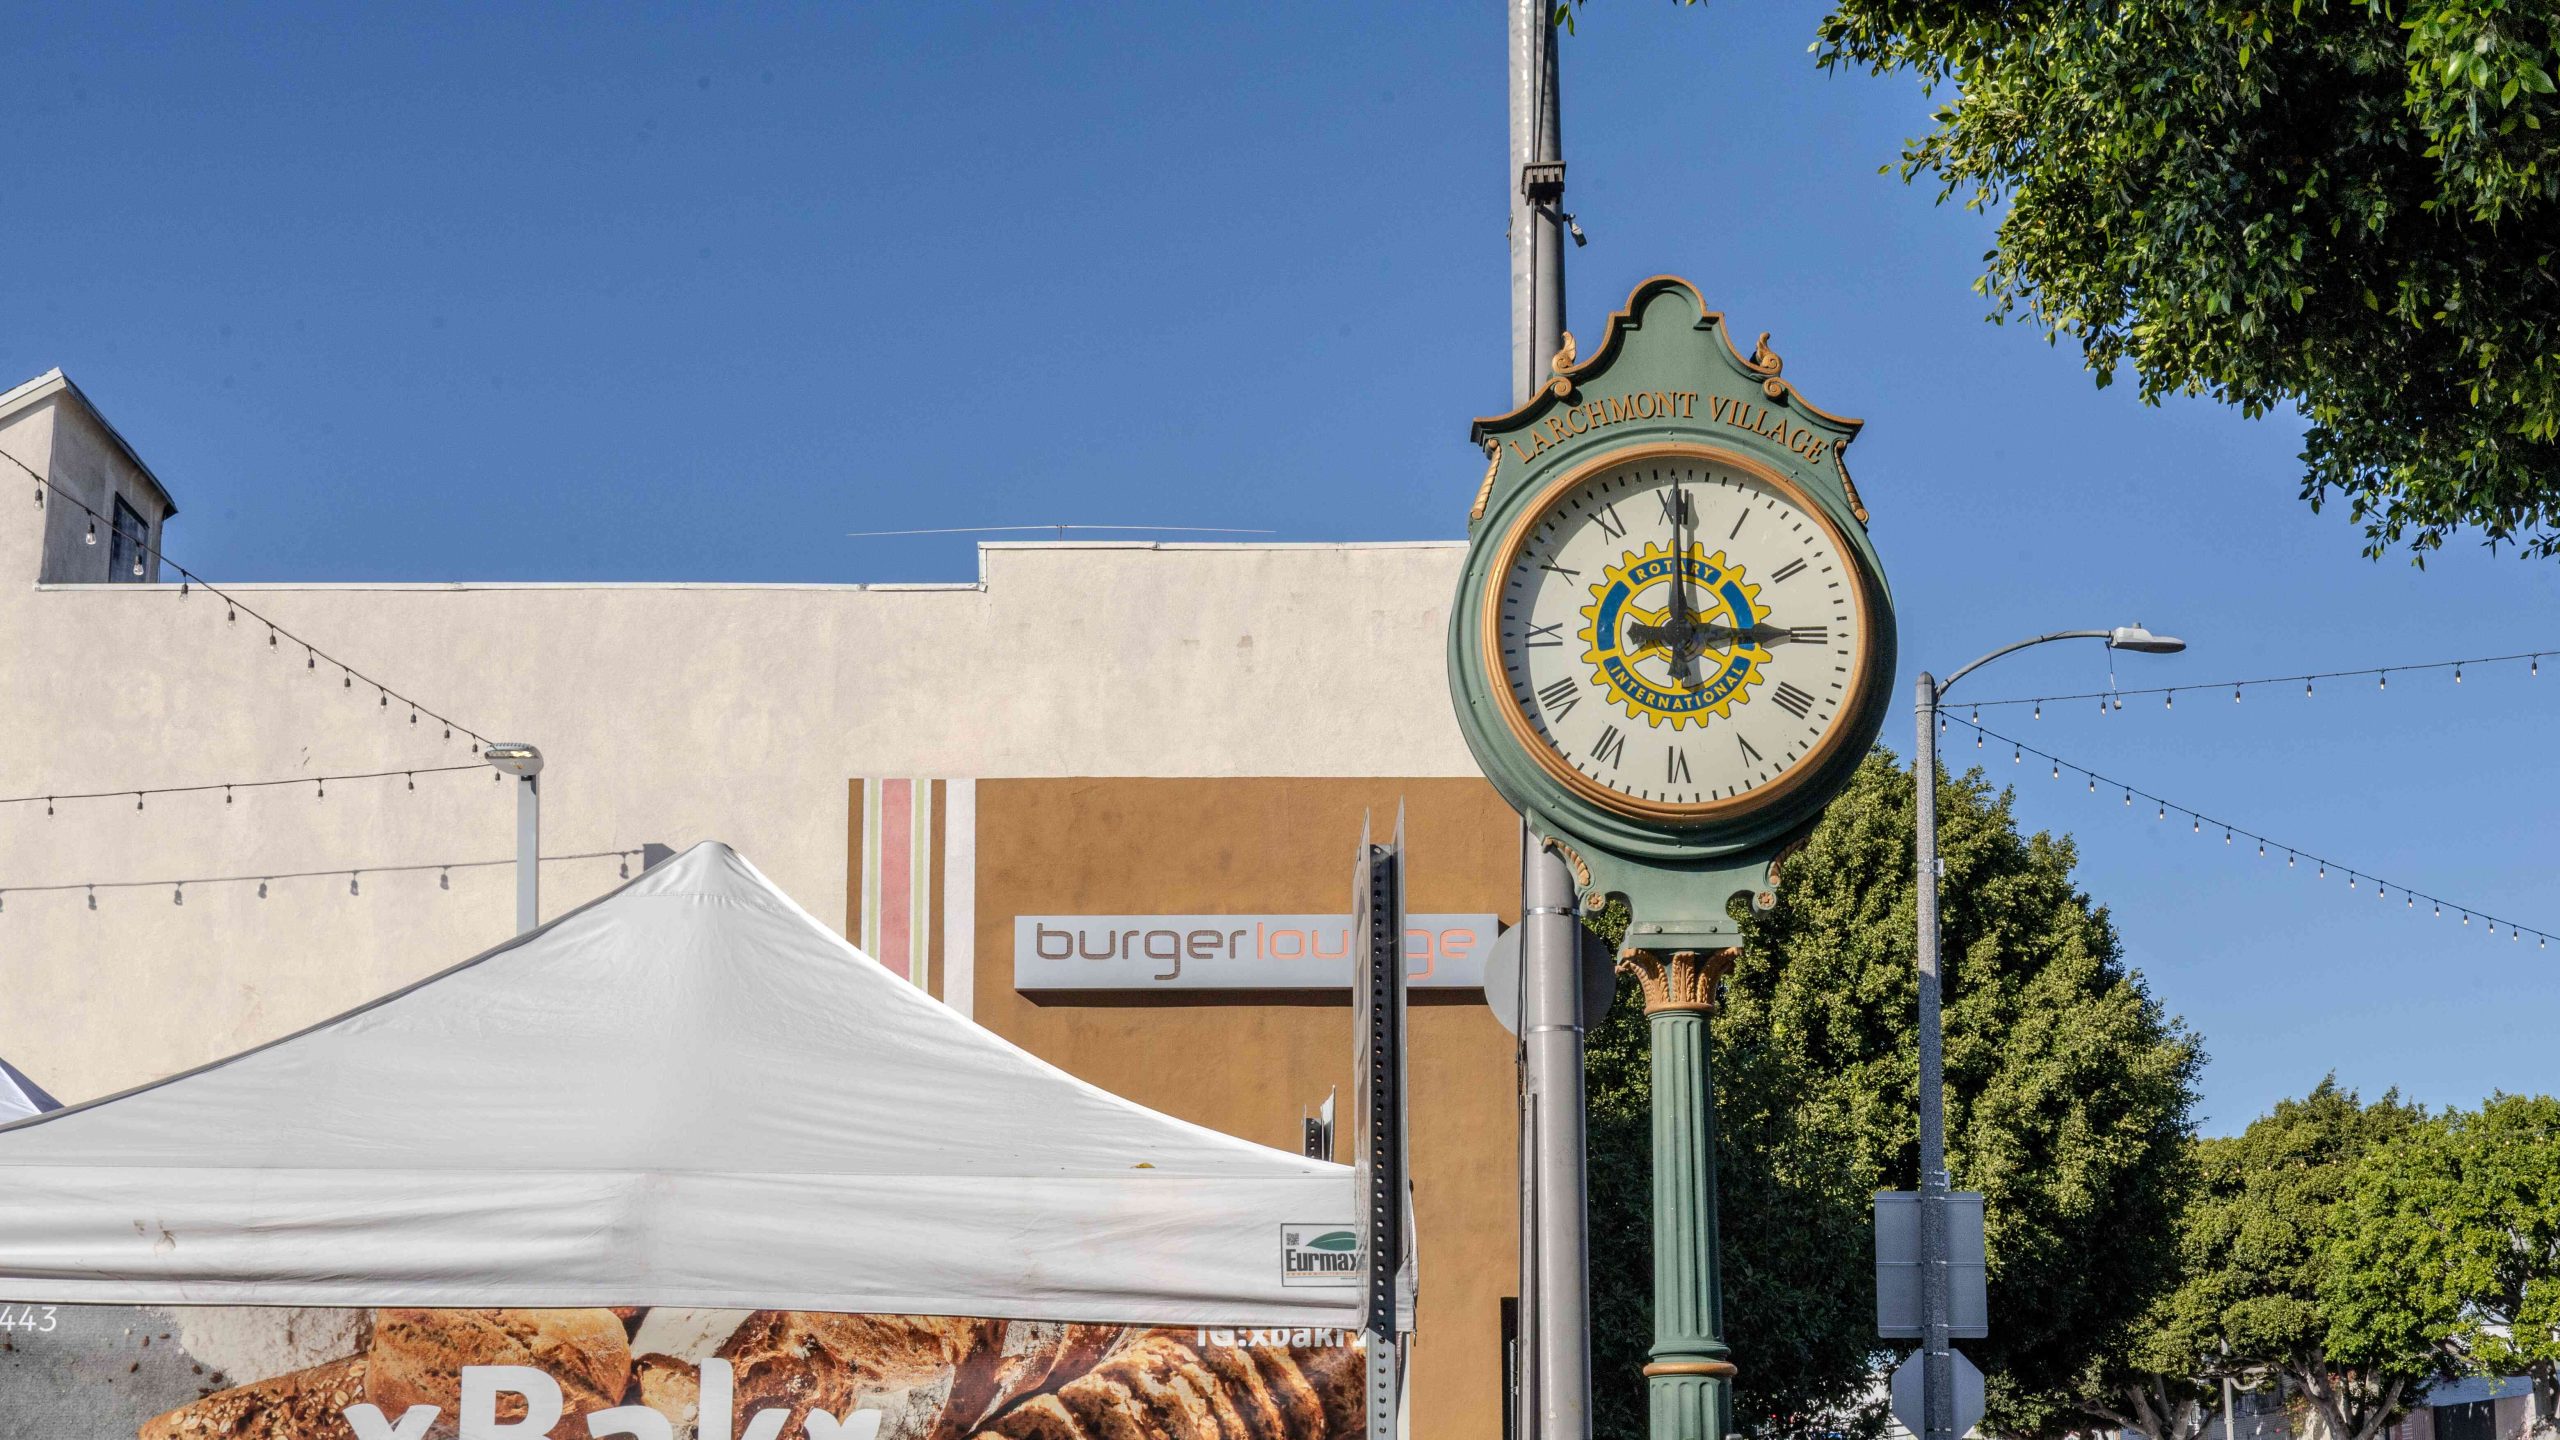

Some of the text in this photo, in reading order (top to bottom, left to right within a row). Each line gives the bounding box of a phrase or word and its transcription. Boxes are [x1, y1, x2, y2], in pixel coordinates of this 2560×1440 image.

[1509, 391, 1829, 464] LARCHMONT VILLAGE
[1588, 502, 1627, 545] XI
[1729, 507, 1750, 540] I
[1540, 554, 1581, 587] X
[1771, 557, 1808, 584] II
[1525, 622, 1563, 648] IX
[1790, 626, 1828, 644] III
[1538, 676, 1582, 724] VIII
[1610, 666, 1744, 710] INTERNATIONAL
[1771, 681, 1815, 720] IIII
[1590, 724, 1626, 770] VII
[1668, 745, 1691, 784] VI
[1736, 732, 1763, 768] V
[1257, 922, 1478, 980] louge
[0, 1306, 57, 1332] 443
